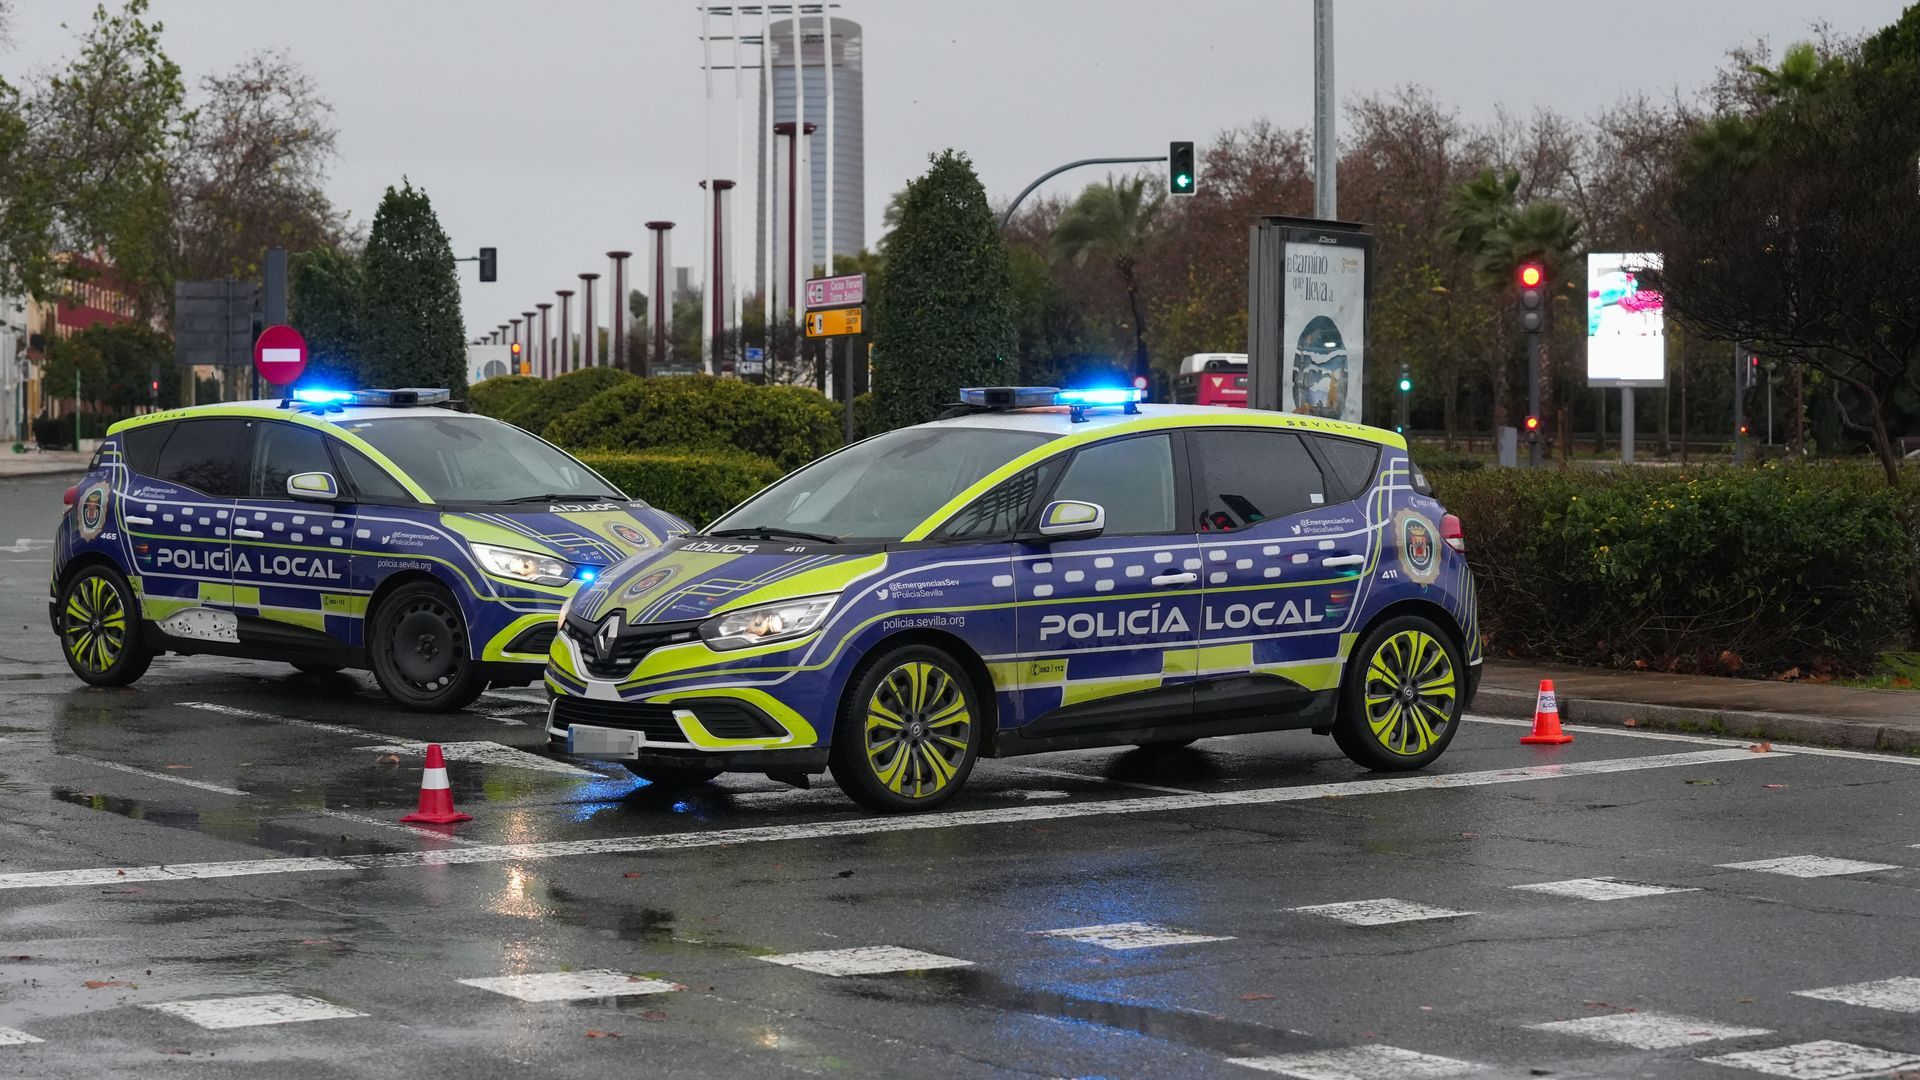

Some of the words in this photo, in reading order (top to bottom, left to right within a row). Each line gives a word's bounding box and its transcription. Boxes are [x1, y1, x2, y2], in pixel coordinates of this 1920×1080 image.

[1293, 251, 1328, 275] camino
[1305, 276, 1328, 302] lleva
[1329, 289, 1334, 302] a
[136, 412, 185, 420] SEVILLA
[1286, 420, 1366, 431] SEVILLA
[1299, 517, 1354, 527] @EmergenciasSev
[100, 532, 117, 540] 465
[391, 532, 440, 541] @EmergenciasSev
[157, 547, 253, 573] POLICÍA
[260, 554, 342, 580] LOCAL
[377, 560, 432, 572] policia.sevilla.org
[1382, 569, 1398, 579] 411
[889, 578, 960, 592] @EmergenciasSev
[892, 588, 944, 599] #PoliciaSevilla
[883, 615, 965, 632] policia.sevilla.org
[1040, 602, 1190, 641] POLICÍA
[1205, 599, 1324, 631] LOCAL
